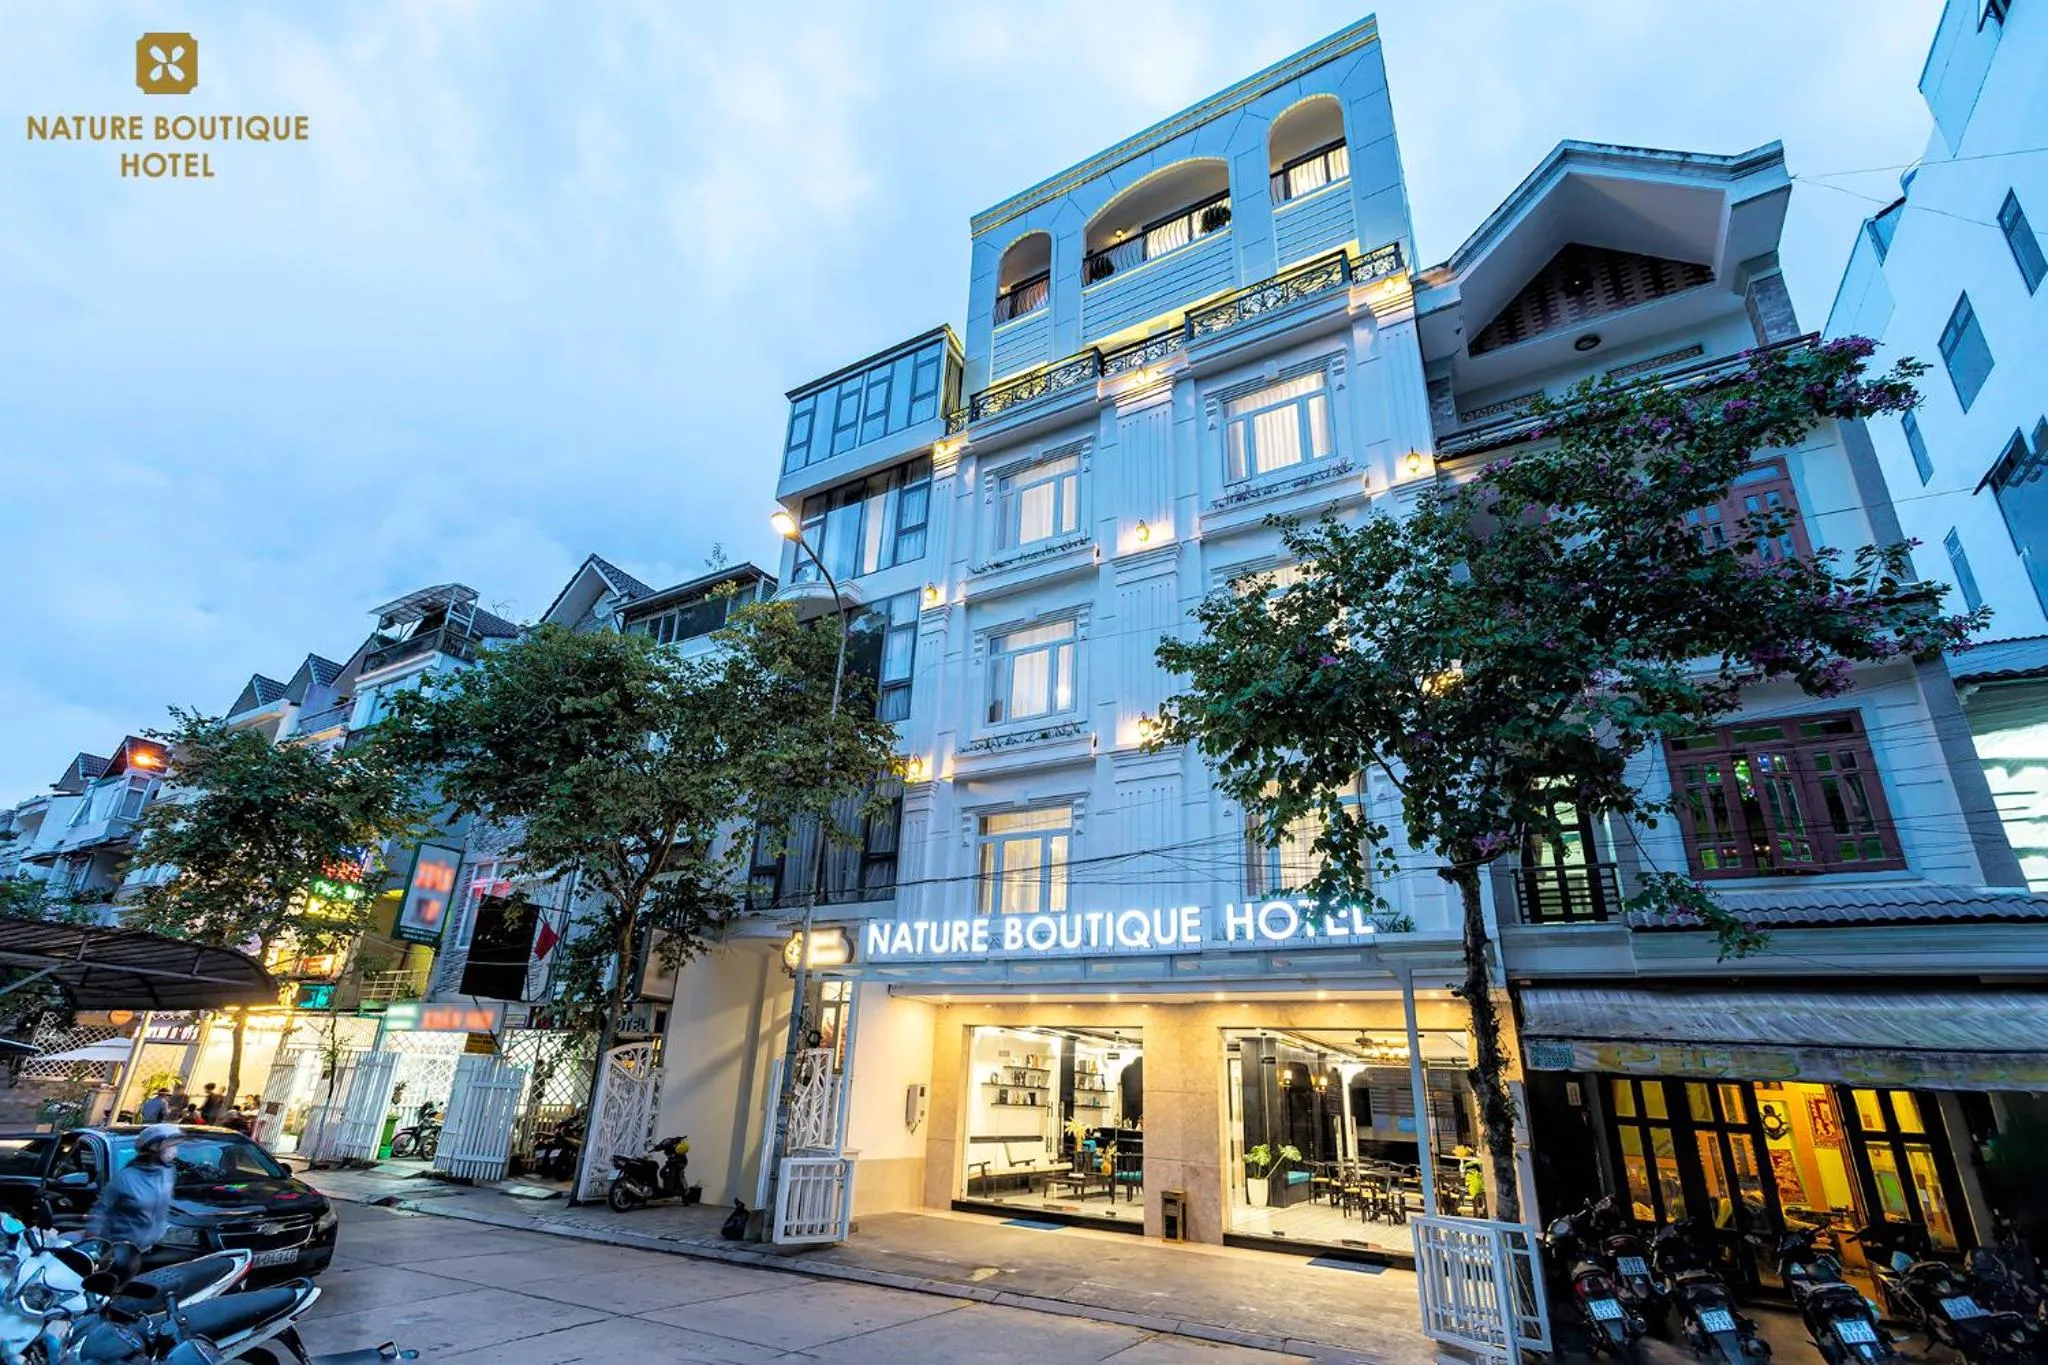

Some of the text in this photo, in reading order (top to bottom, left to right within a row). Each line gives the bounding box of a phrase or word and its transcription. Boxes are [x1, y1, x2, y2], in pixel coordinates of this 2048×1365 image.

[867, 918, 989, 955] NATURE
[1003, 905, 1201, 951] BOUTIQUE
[1226, 900, 1375, 941] HOTEL
